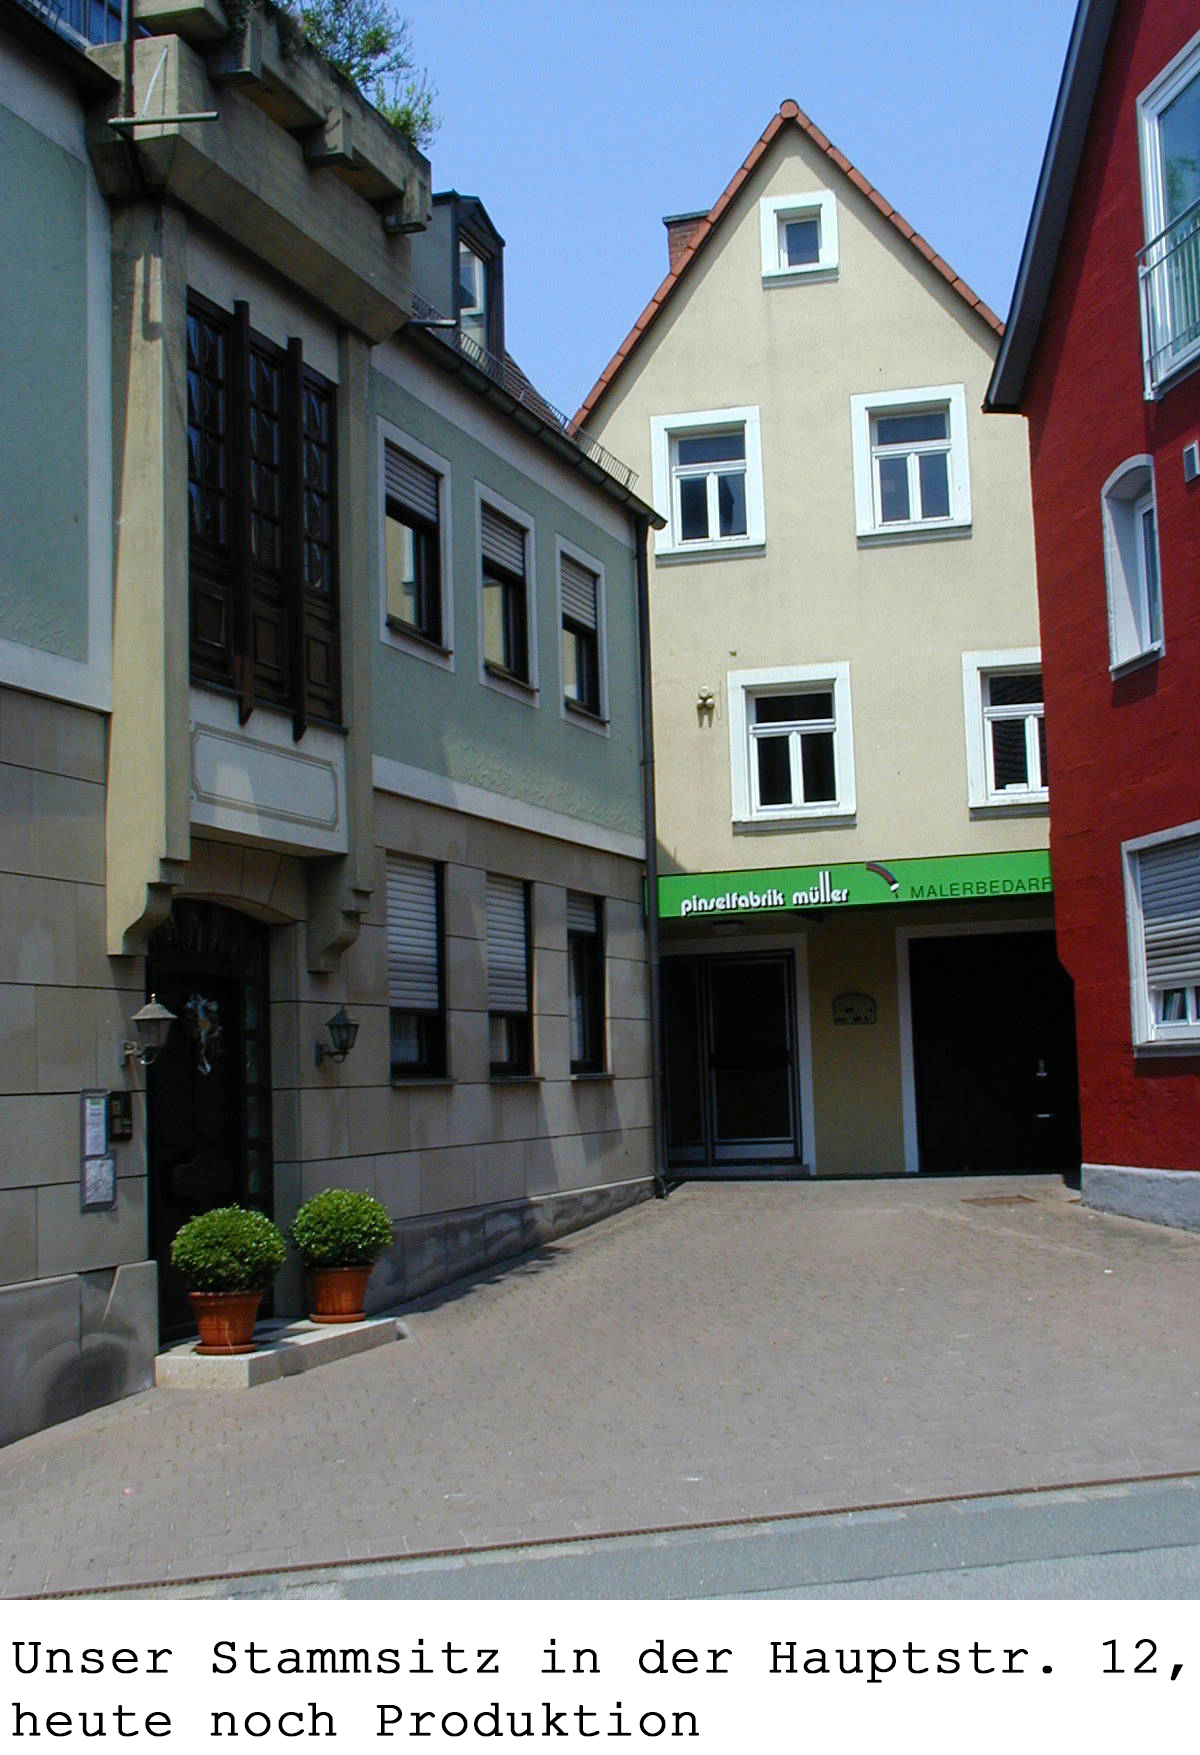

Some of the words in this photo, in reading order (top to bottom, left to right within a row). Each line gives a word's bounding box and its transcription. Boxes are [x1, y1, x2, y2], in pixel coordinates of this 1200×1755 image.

[681, 889, 784, 917] pinselfabrik
[792, 871, 849, 905] müller
[910, 877, 1053, 899] MALERBEDARF
